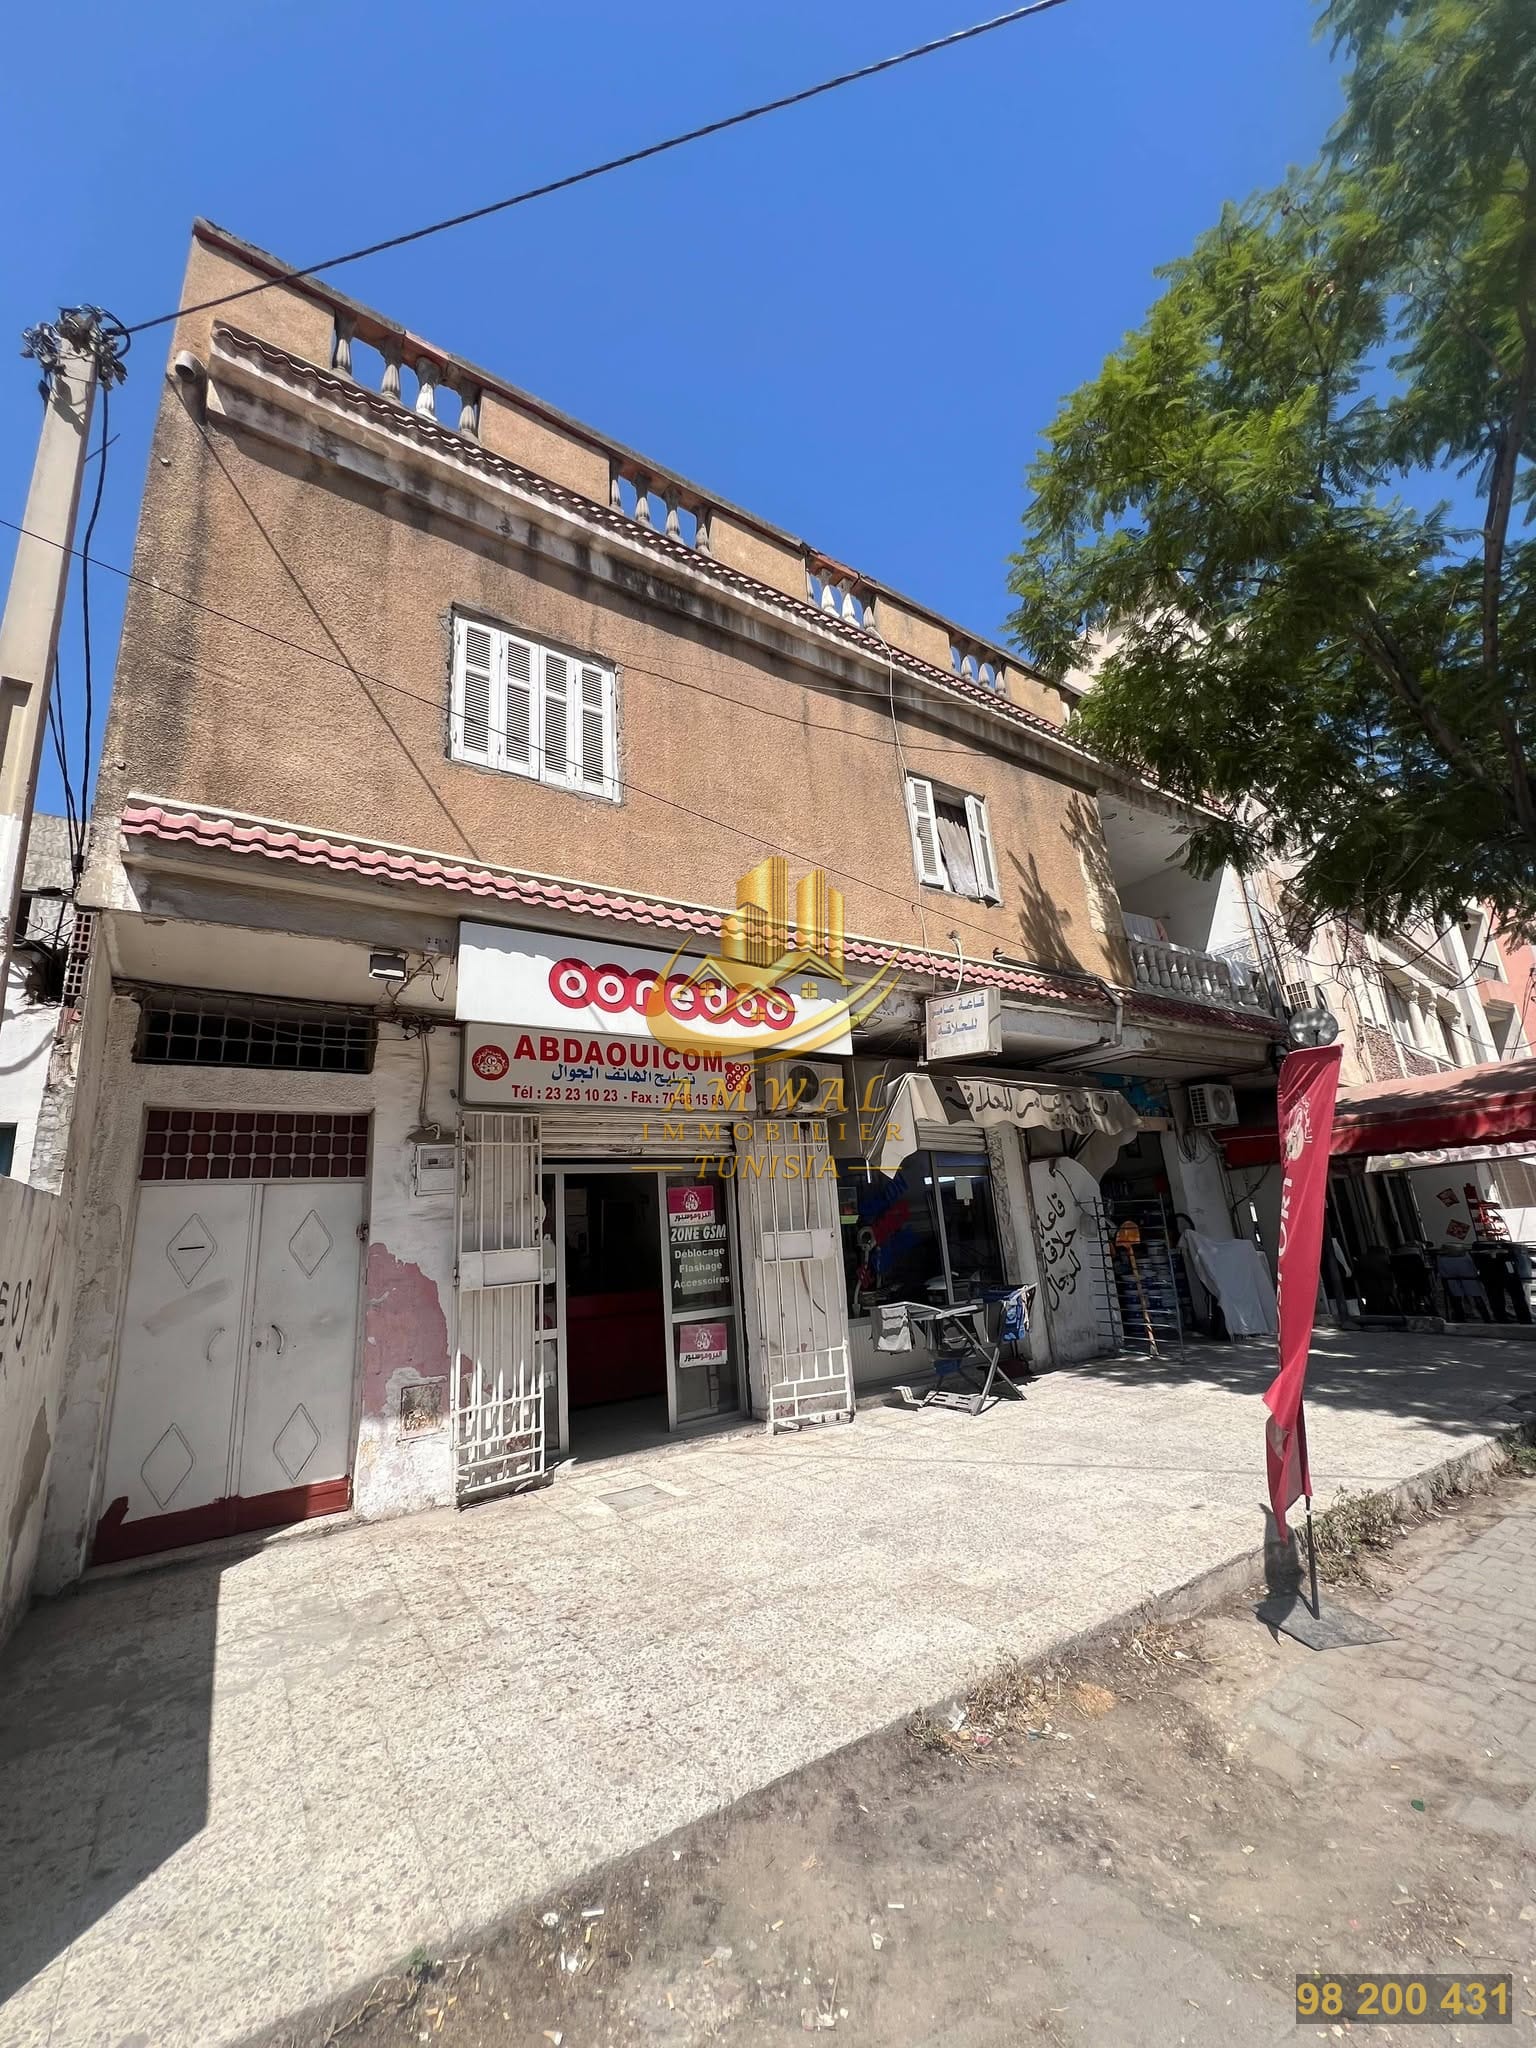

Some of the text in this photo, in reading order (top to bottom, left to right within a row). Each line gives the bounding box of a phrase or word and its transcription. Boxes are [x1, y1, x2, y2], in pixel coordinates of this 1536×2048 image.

[558, 968, 789, 1022] ooredoo
[514, 1034, 723, 1073] ABDAOUICOM
[551, 1063, 599, 1083] الجوال
[605, 1067, 652, 1084] الهاتف
[512, 1084, 532, 1099] Tél
[545, 1087, 561, 1100] 23
[565, 1087, 581, 1101] 23
[585, 1089, 600, 1102] 10
[603, 1089, 618, 1102] 23
[631, 1091, 652, 1104] Fax
[662, 1092, 676, 1105] 70
[696, 1094, 708, 1106] 15
[671, 1223, 727, 1242] ZONE GSM
[679, 1262, 723, 1273] Flashage
[673, 1275, 730, 1289] Accessoires
